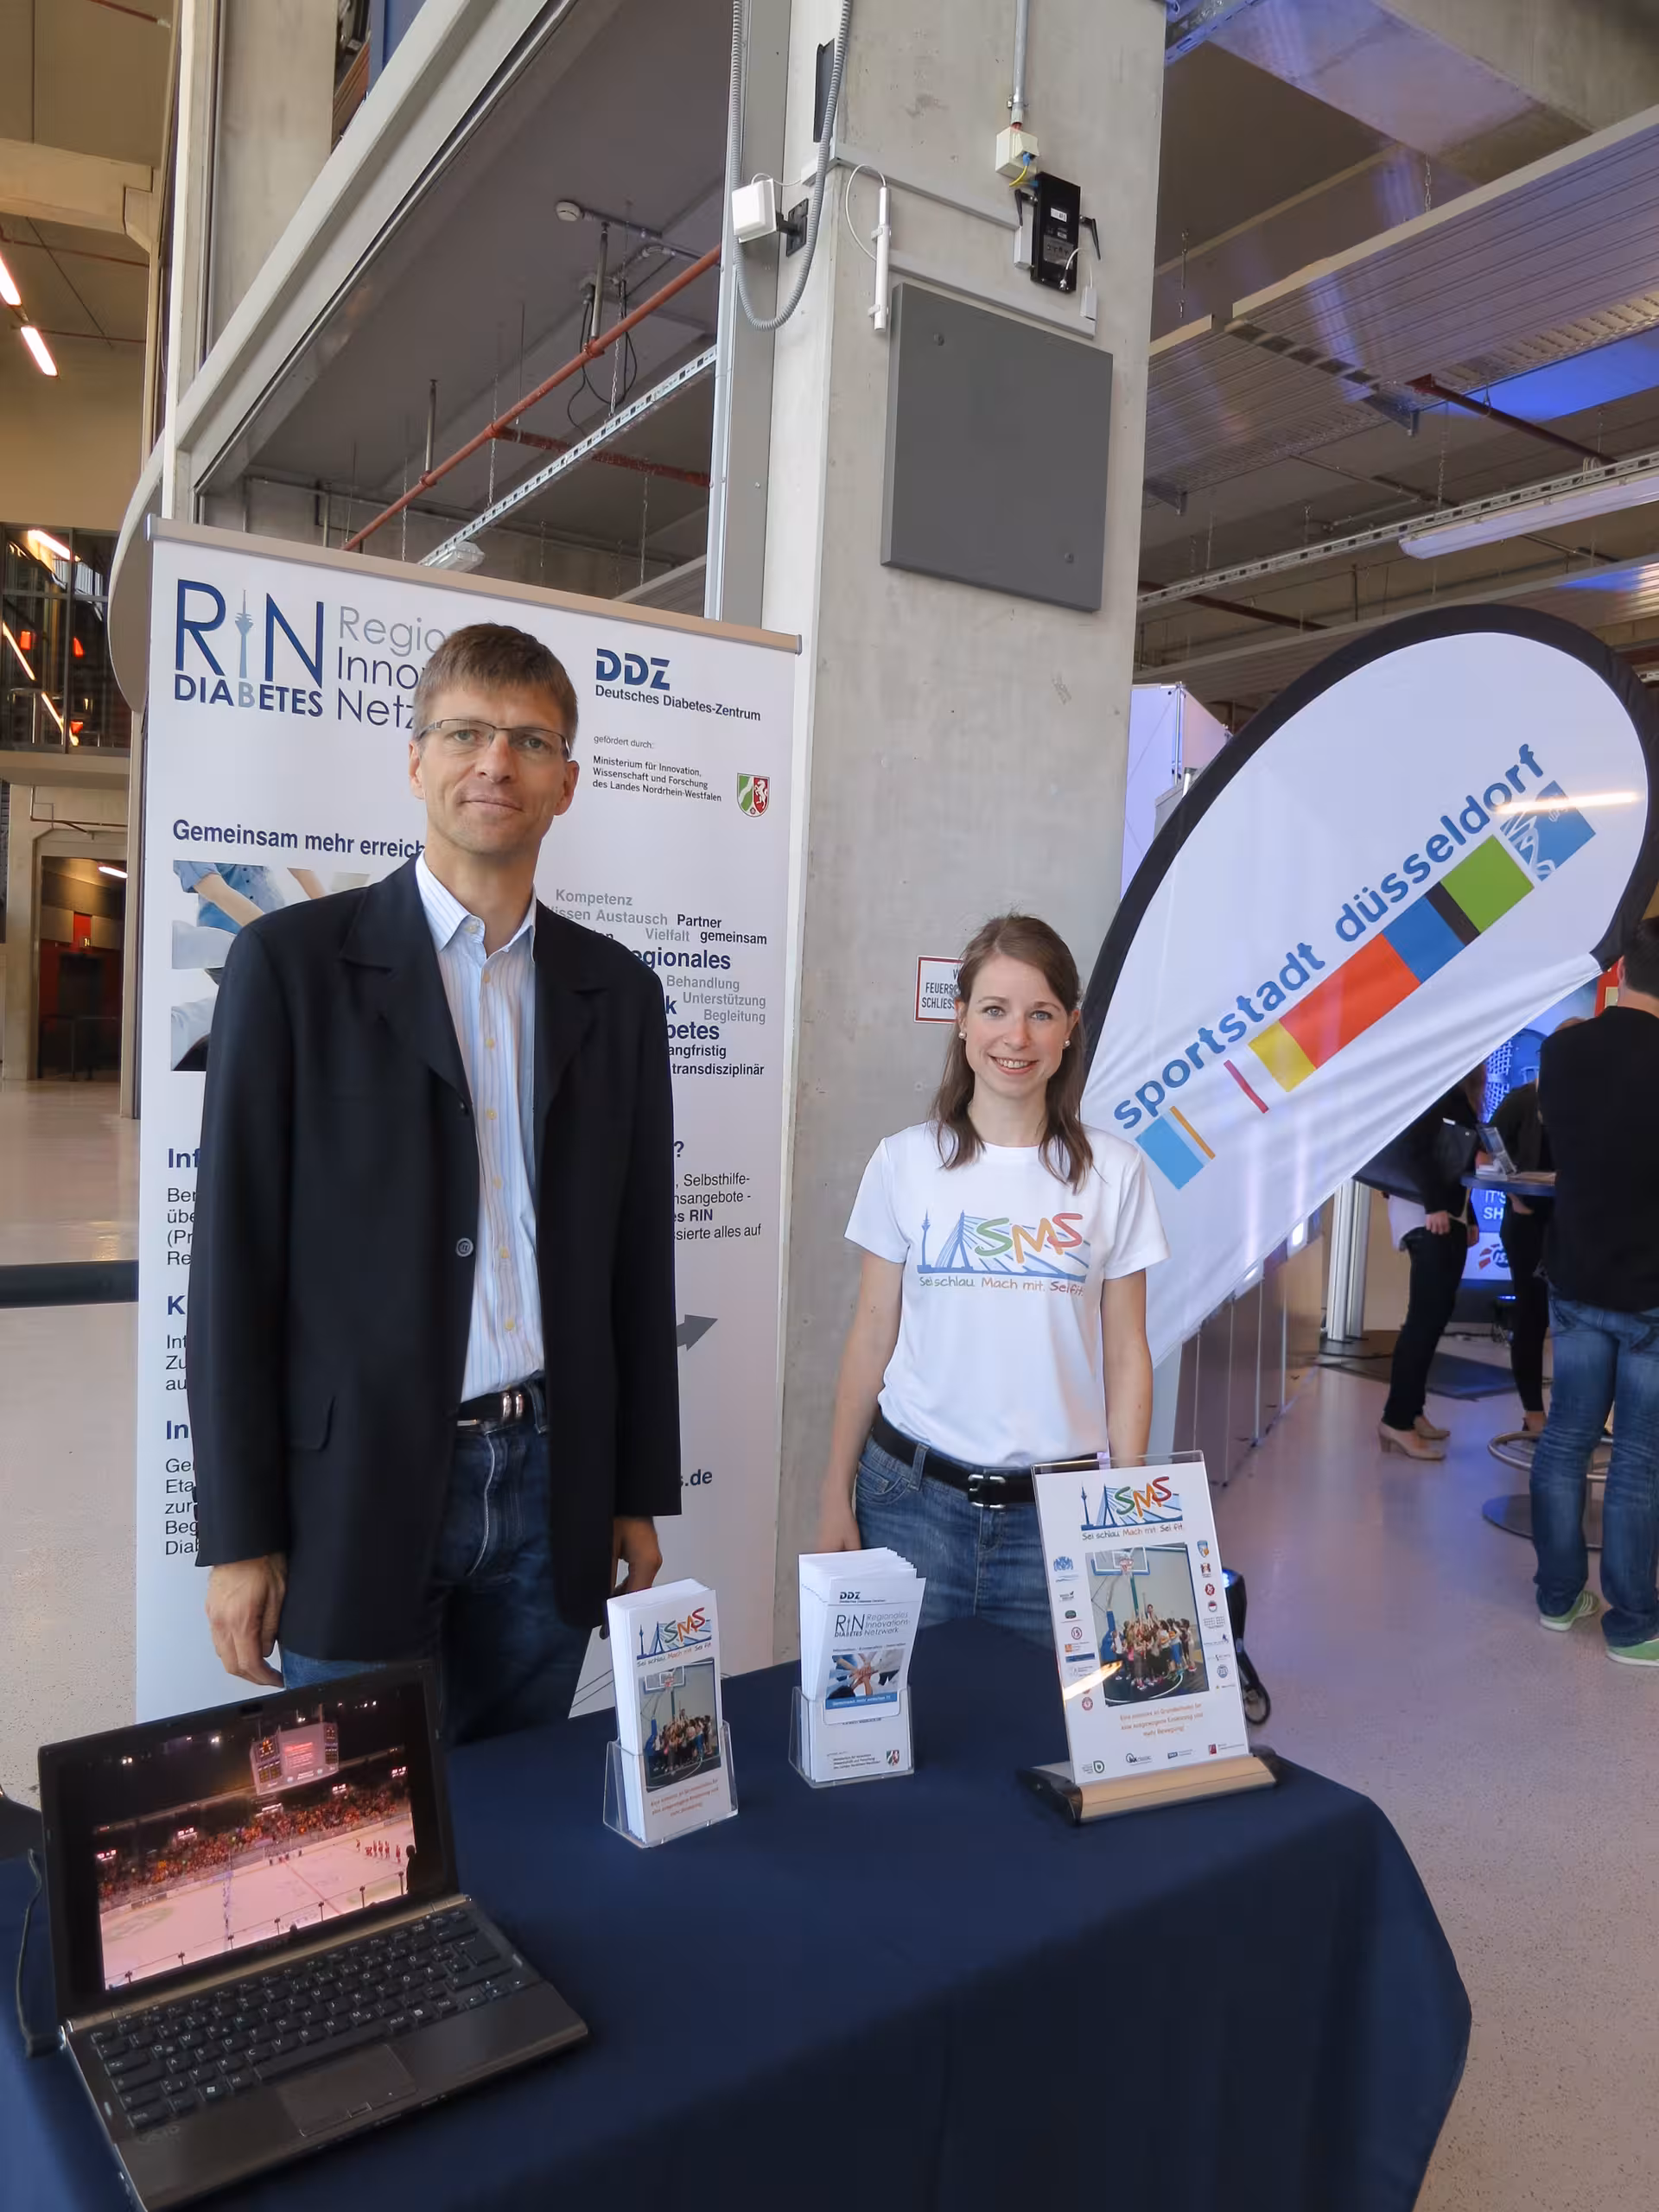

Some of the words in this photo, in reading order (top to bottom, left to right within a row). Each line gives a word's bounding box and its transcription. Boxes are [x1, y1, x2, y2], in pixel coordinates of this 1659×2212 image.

[338, 646, 425, 690] Inno
[596, 647, 671, 691] DDZ
[175, 673, 323, 717] DIABETES
[595, 684, 659, 704] Deutsches
[663, 694, 761, 721] Diabetes-Zentrum
[594, 735, 629, 747] gefördert
[631, 738, 654, 749] durch:
[593, 755, 643, 769] Ministerium
[645, 761, 658, 771] für
[659, 763, 702, 777] Innovation,
[593, 767, 649, 781] Wissenschaft
[651, 774, 666, 784] und
[668, 776, 709, 790] Forschung
[593, 779, 608, 789] des
[610, 780, 640, 792] Landes
[642, 785, 722, 802] Nordrhein-Westfalen
[173, 819, 298, 849] Gemeinsam
[305, 833, 355, 853] mehr
[556, 889, 633, 906] Kompetenz
[546, 906, 591, 921] issen
[595, 909, 668, 925] Austausch
[677, 913, 722, 929] Partner
[645, 928, 690, 943] Vielfalt
[700, 930, 767, 944] gemeinsam
[1113, 943, 1325, 1129] sportstadt
[1335, 743, 1544, 943] düsseldorf
[666, 975, 740, 993] Behandlung
[683, 992, 766, 1009] Unterstützung
[703, 1009, 766, 1025] Begleitung
[672, 1063, 765, 1077] transdisziplinär
[683, 1173, 750, 1187] Selbsthilfe-
[690, 1209, 713, 1222] RIN
[714, 1225, 741, 1238] alles
[744, 1224, 762, 1236] auf
[975, 1212, 1084, 1263] SMS
[982, 1277, 1018, 1289] Mach
[1114, 1476, 1172, 1518] SMS
[1082, 1532, 1095, 1541] Sei
[839, 1592, 861, 1600] DDZ
[867, 1611, 909, 1621] Regionales
[664, 1607, 706, 1643] SMS
[864, 1626, 899, 1637] Netzwerk
